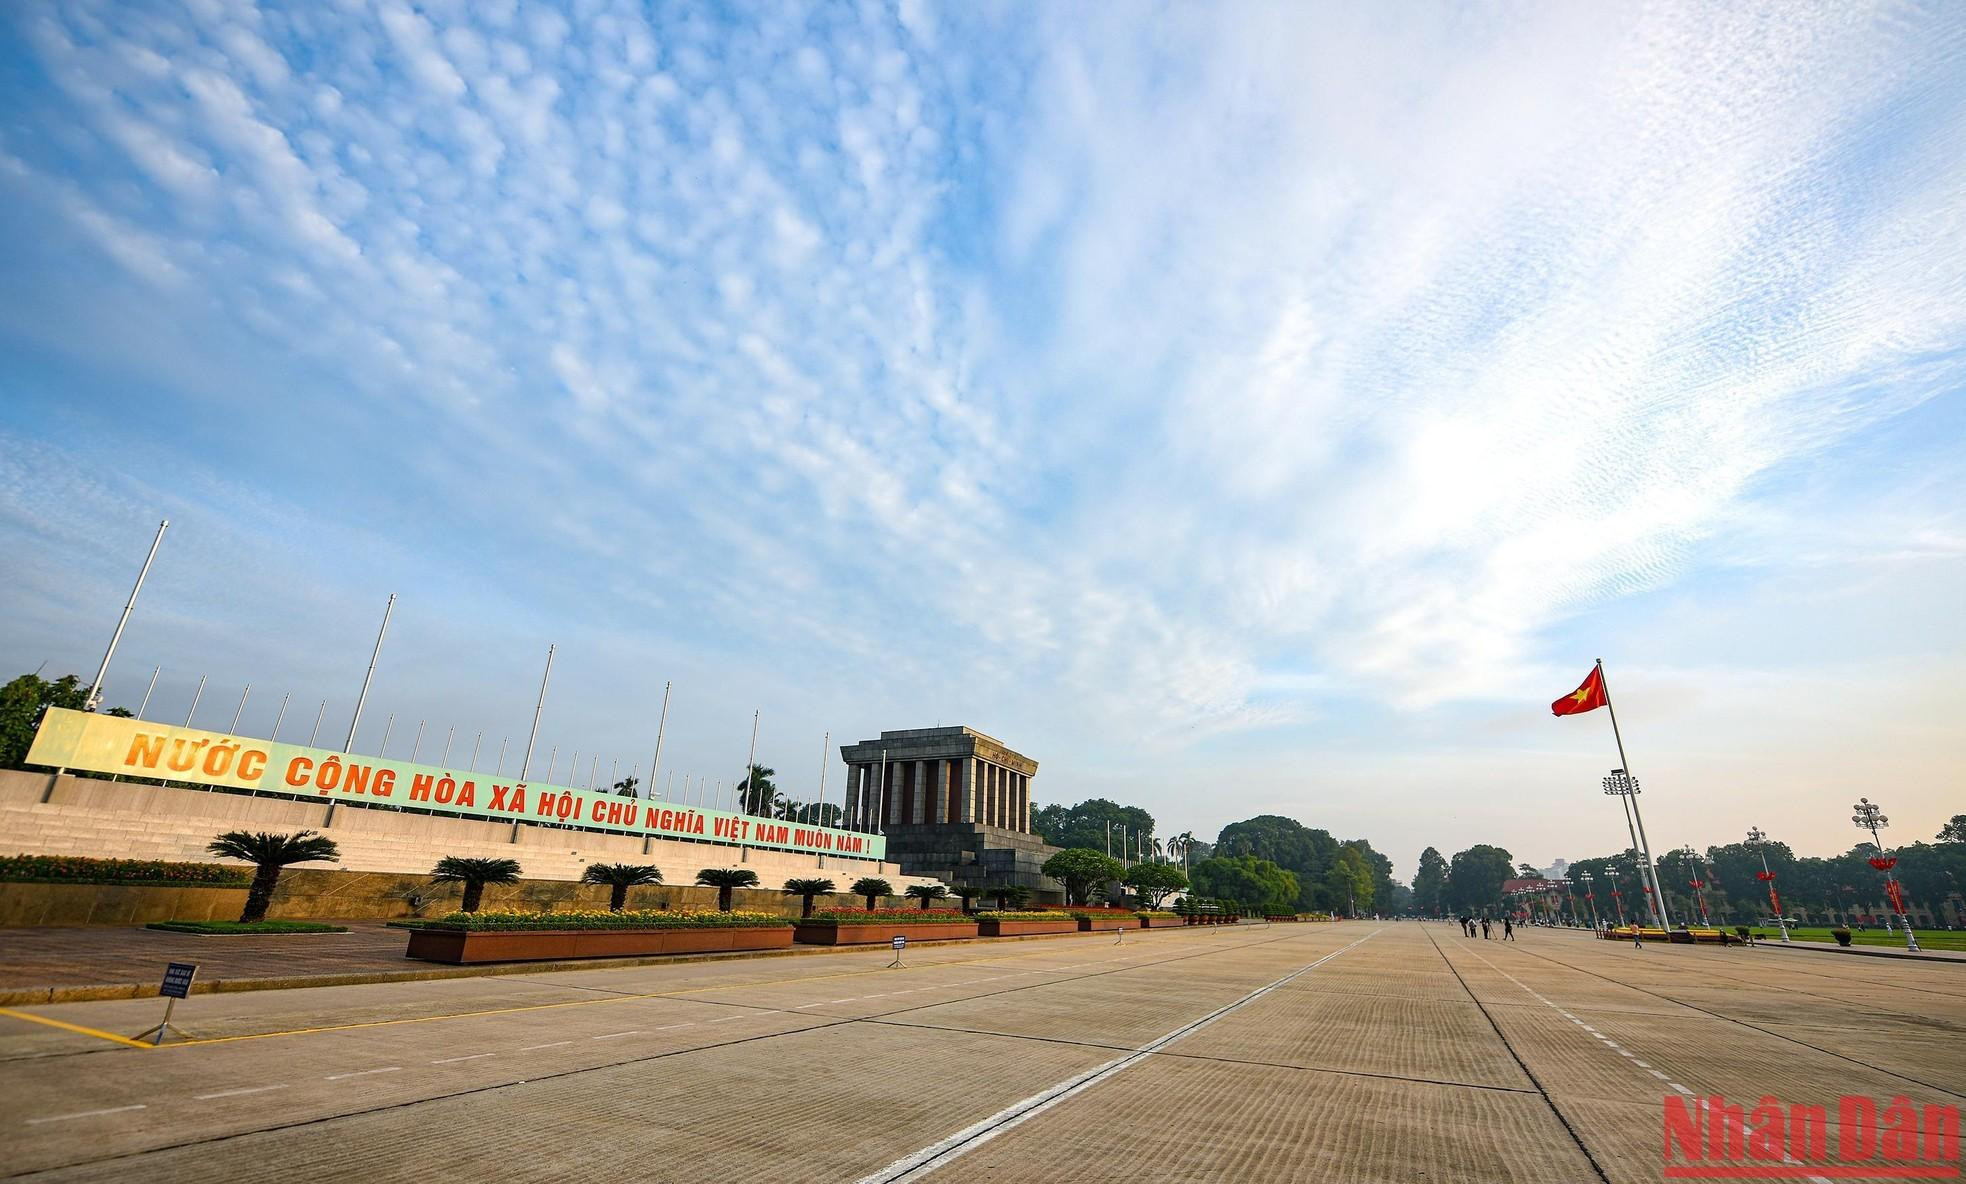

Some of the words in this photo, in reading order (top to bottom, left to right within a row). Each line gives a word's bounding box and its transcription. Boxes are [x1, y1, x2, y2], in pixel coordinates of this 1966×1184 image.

[124, 734, 268, 780] NƯỚC
[286, 755, 395, 797] CỘNG
[410, 772, 475, 808] HÒA
[488, 783, 525, 813] XÃ
[538, 791, 582, 822] HỘI
[592, 798, 637, 827] CHỦ
[646, 807, 704, 834] NGHĨA
[714, 816, 749, 841] VIỆT
[756, 823, 789, 844] NAM
[794, 829, 831, 849] MUÔN
[836, 834, 862, 853] NĂM
